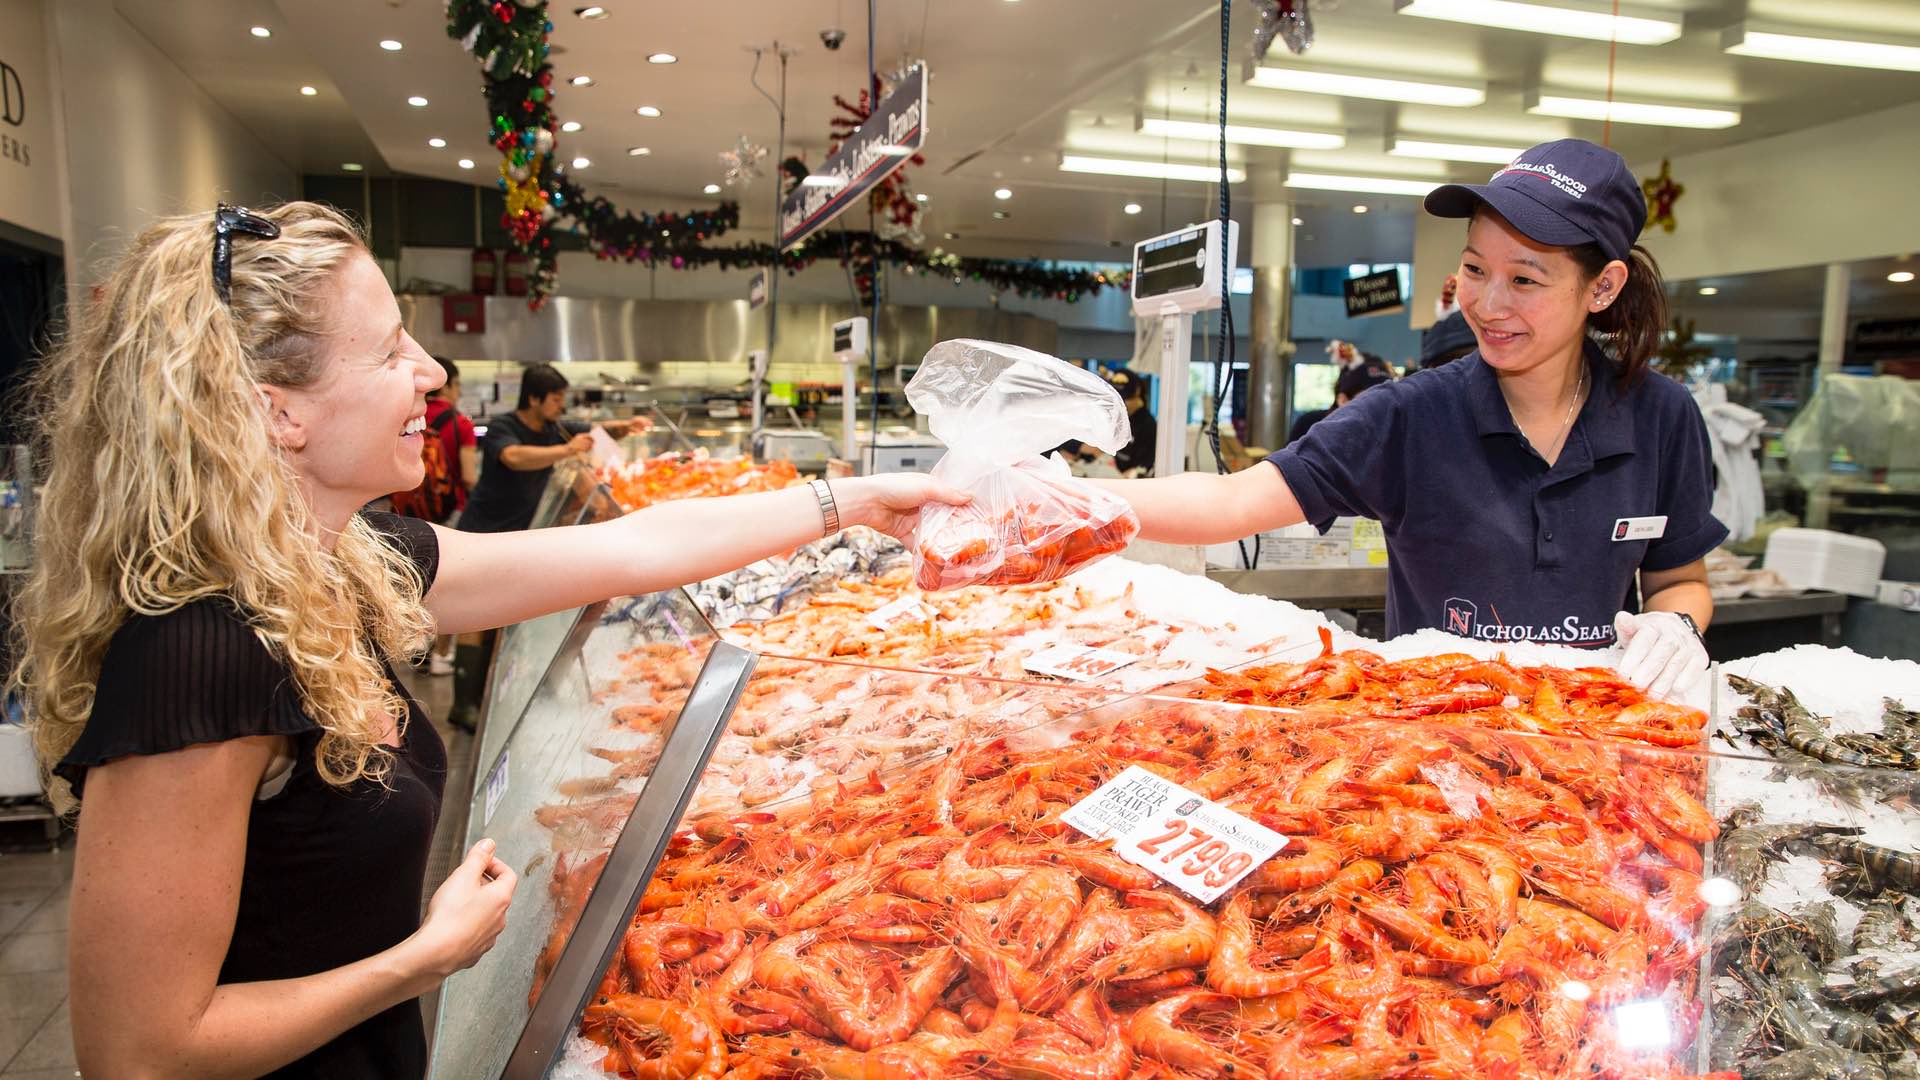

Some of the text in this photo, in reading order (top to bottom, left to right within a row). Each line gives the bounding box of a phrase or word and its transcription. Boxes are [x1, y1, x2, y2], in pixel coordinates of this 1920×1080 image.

[1551, 178, 1582, 199] TRADERS
[1353, 277, 1389, 294] Please
[1349, 290, 1398, 311] Pay Here
[1122, 779, 1168, 807] TIGER
[1140, 775, 1171, 794] BLACK
[1099, 799, 1141, 824] COOKED
[1103, 787, 1160, 818] PRAWN
[1136, 819, 1253, 888] 2799
